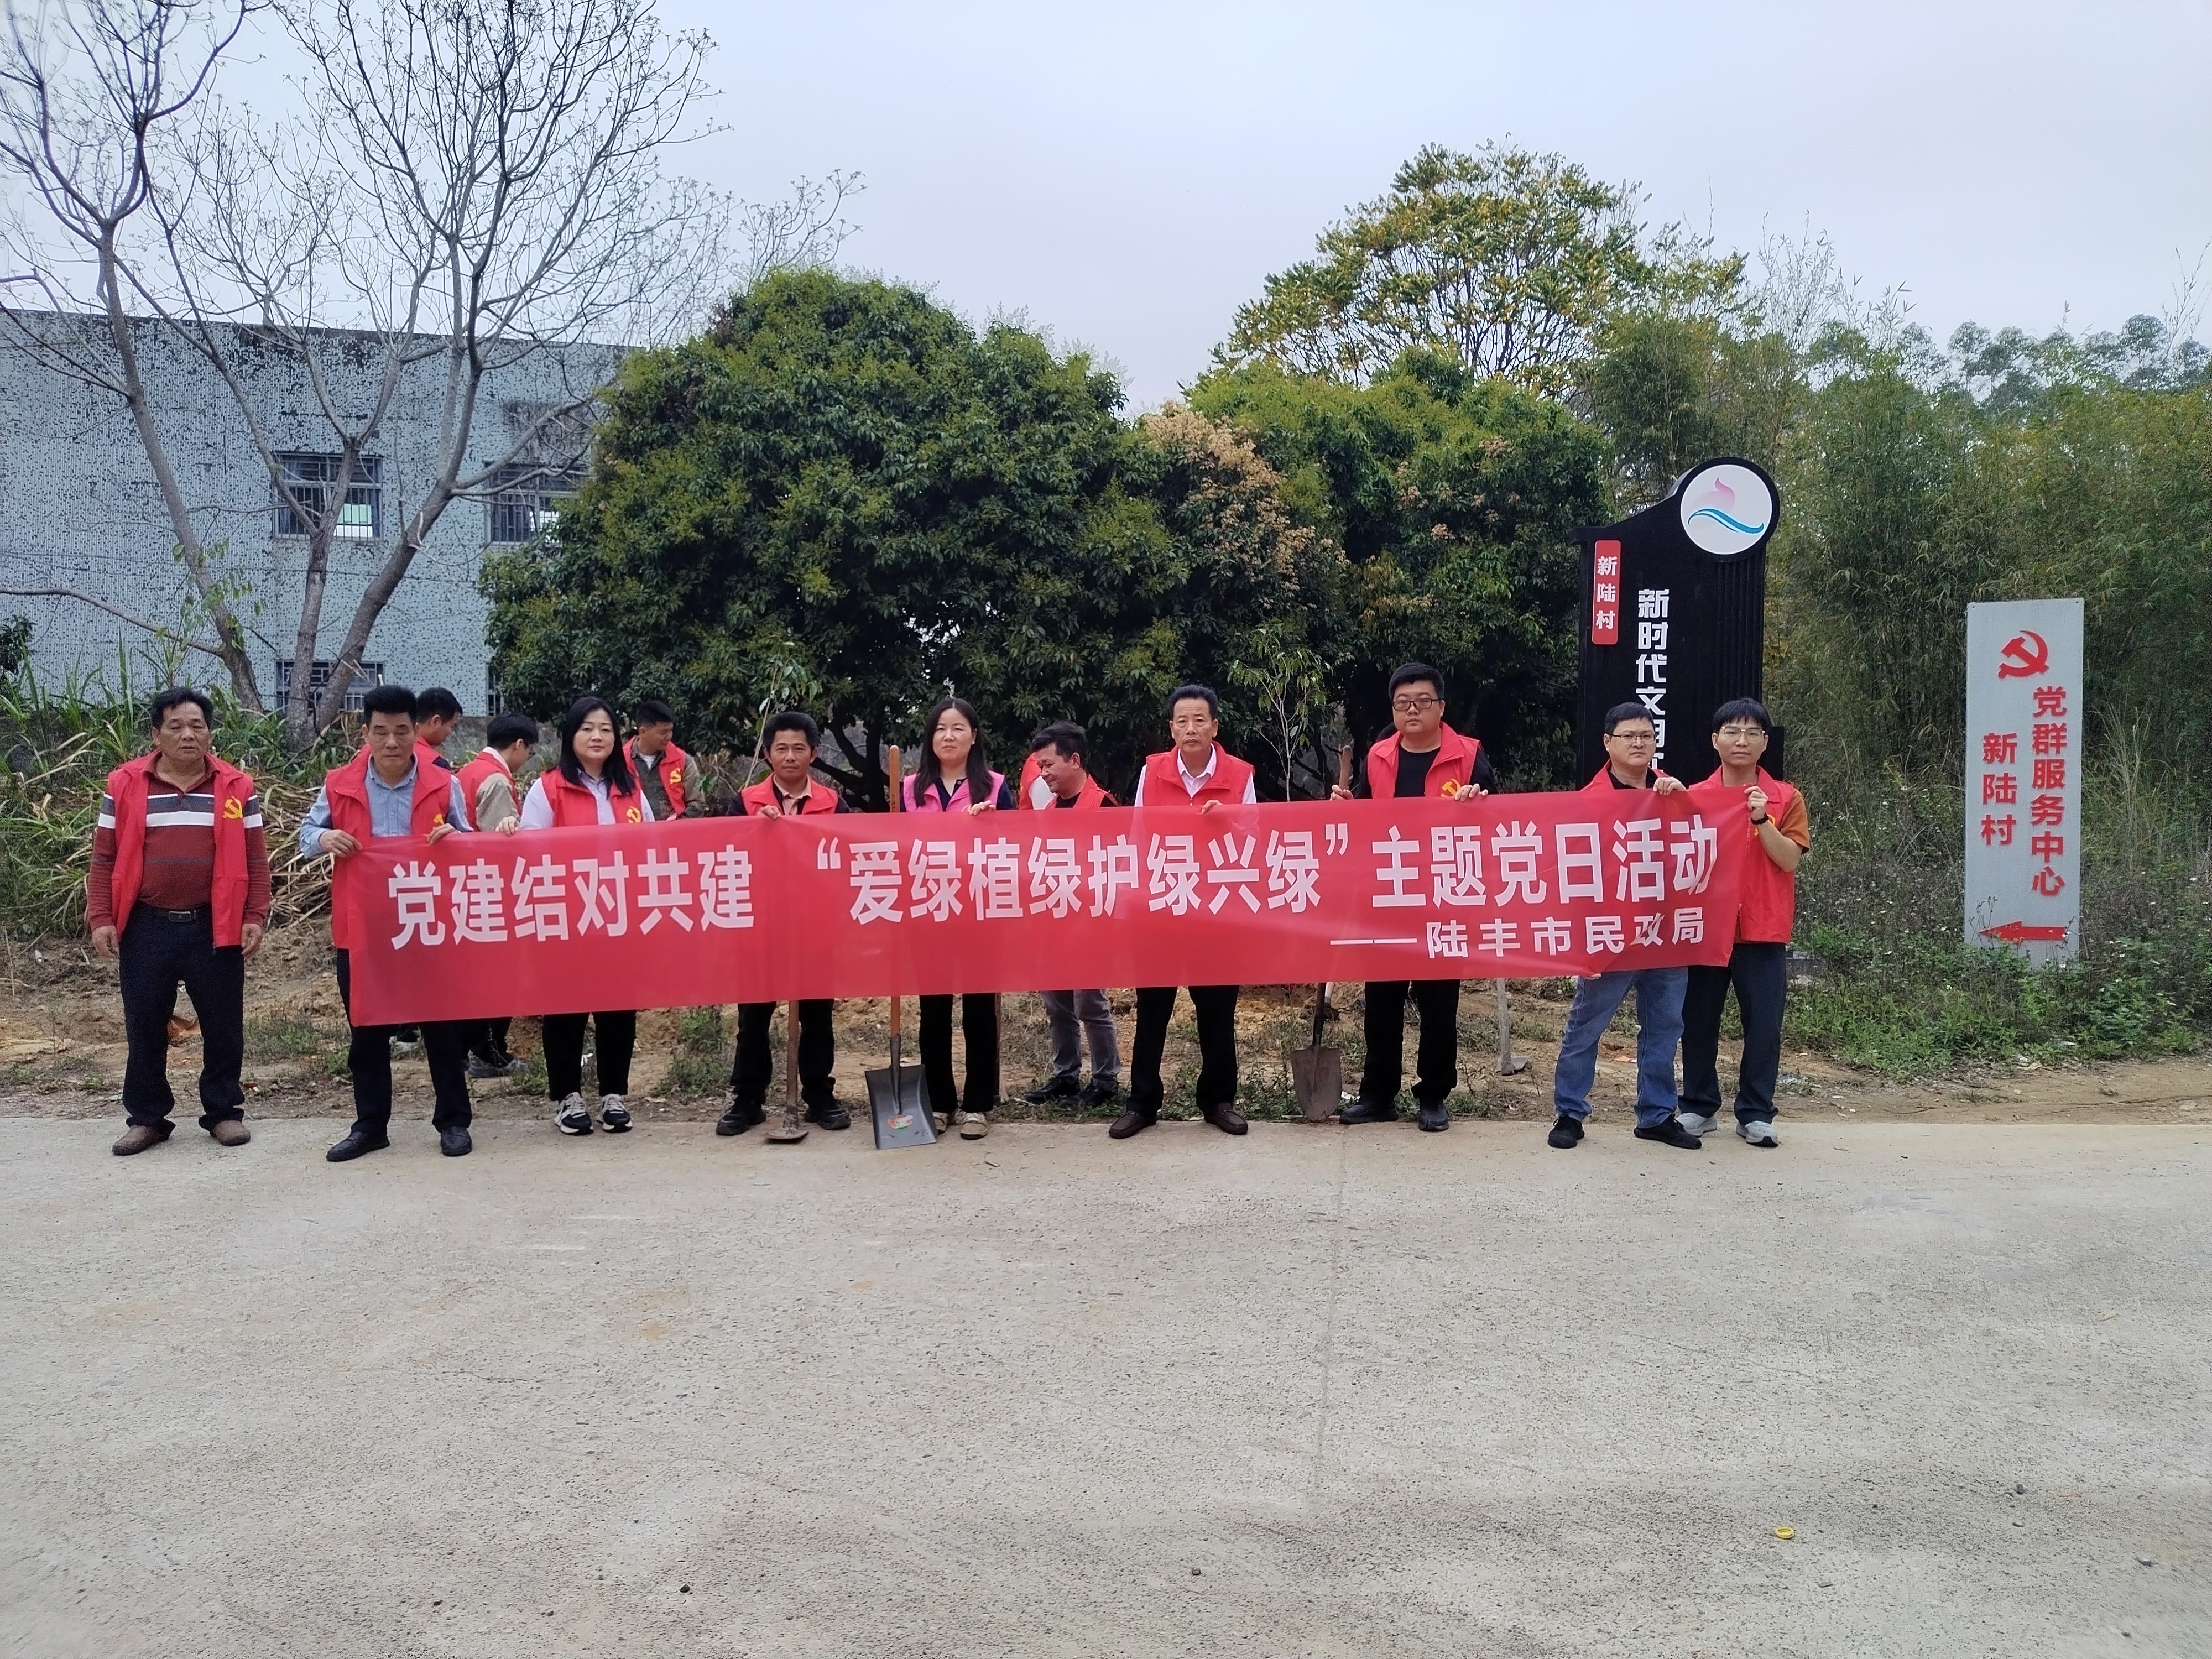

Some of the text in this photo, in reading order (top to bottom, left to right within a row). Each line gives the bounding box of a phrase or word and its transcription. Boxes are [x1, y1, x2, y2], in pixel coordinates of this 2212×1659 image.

[1595, 555, 1618, 630] 新陆村
[1981, 732, 2017, 847] 新陆村
[2030, 685, 2067, 896] 党群服务中心
[388, 844, 755, 950] 党建结对共建
